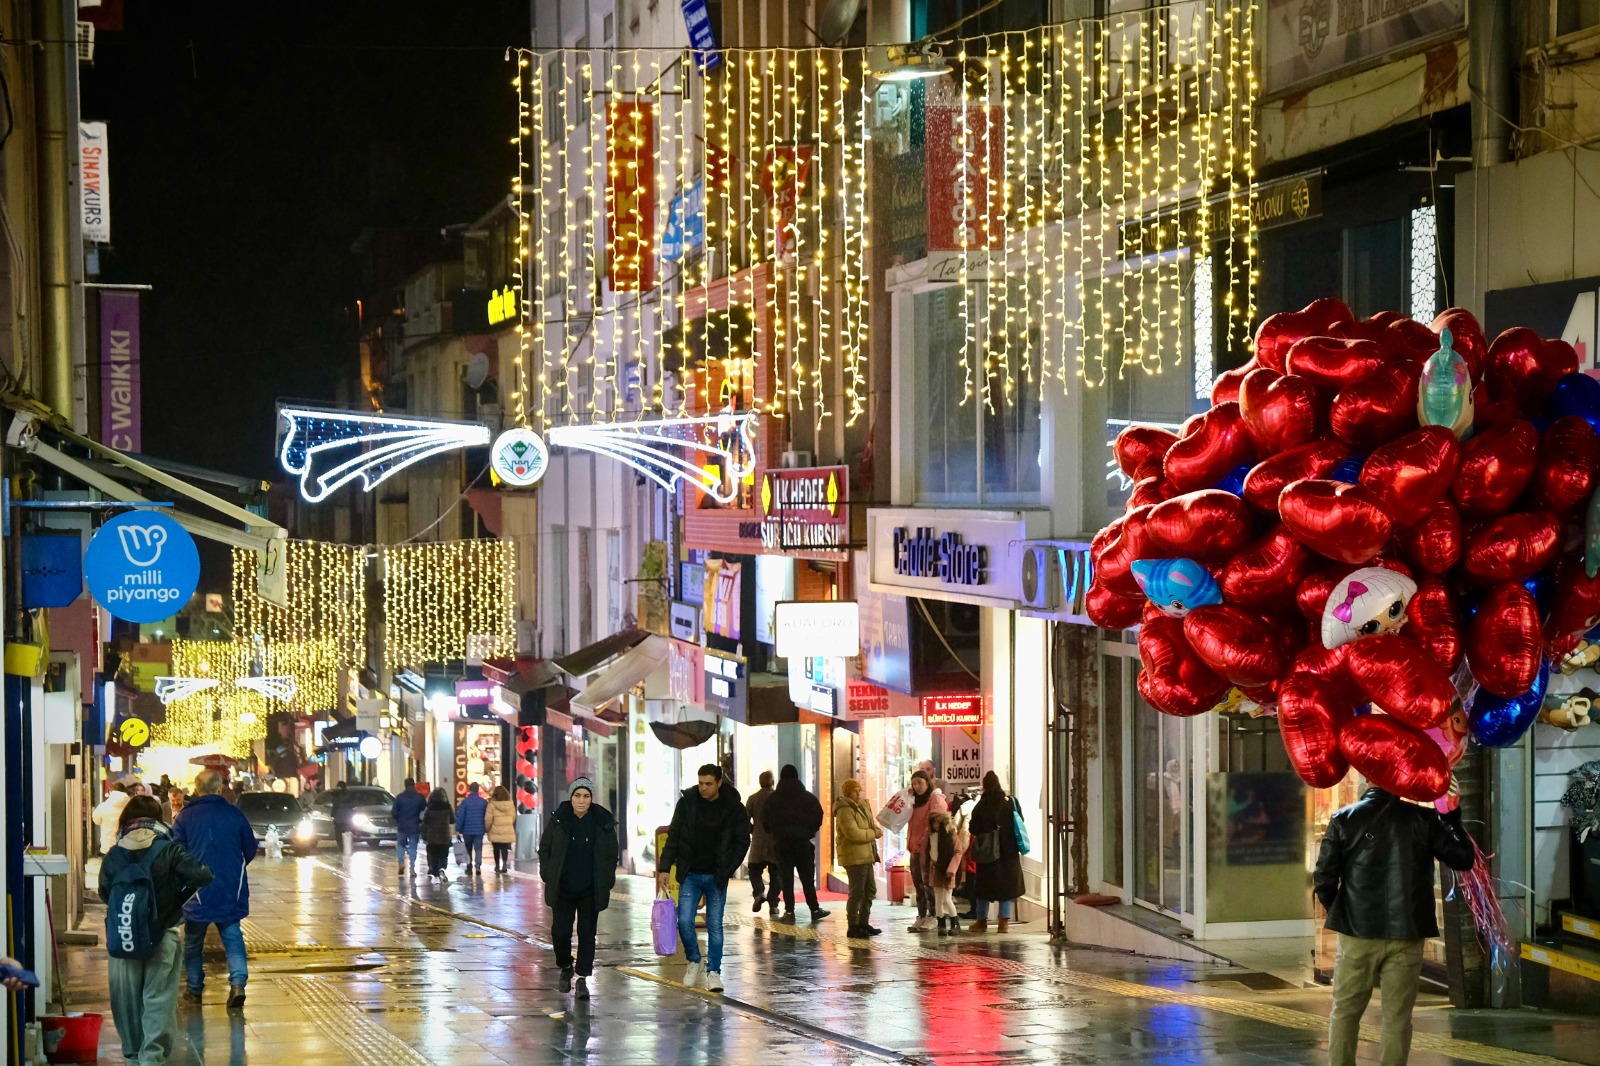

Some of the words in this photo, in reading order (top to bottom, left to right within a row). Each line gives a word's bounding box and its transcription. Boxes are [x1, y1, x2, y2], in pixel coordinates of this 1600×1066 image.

[1219, 205, 1248, 231] BAKI
[940, 531, 989, 585] Store
[124, 570, 162, 585] milli
[107, 586, 180, 603] piyango
[459, 688, 488, 698] AVON
[848, 697, 889, 711] SERVİS
[935, 700, 947, 710] İLK
[948, 702, 971, 710] HEDEF
[928, 713, 955, 723] SÜRÜCÜ
[956, 715, 979, 723] KURSU
[952, 746, 968, 760] İLK
[947, 764, 980, 779] SÜRÜCÜ
[117, 893, 135, 952] adidas
